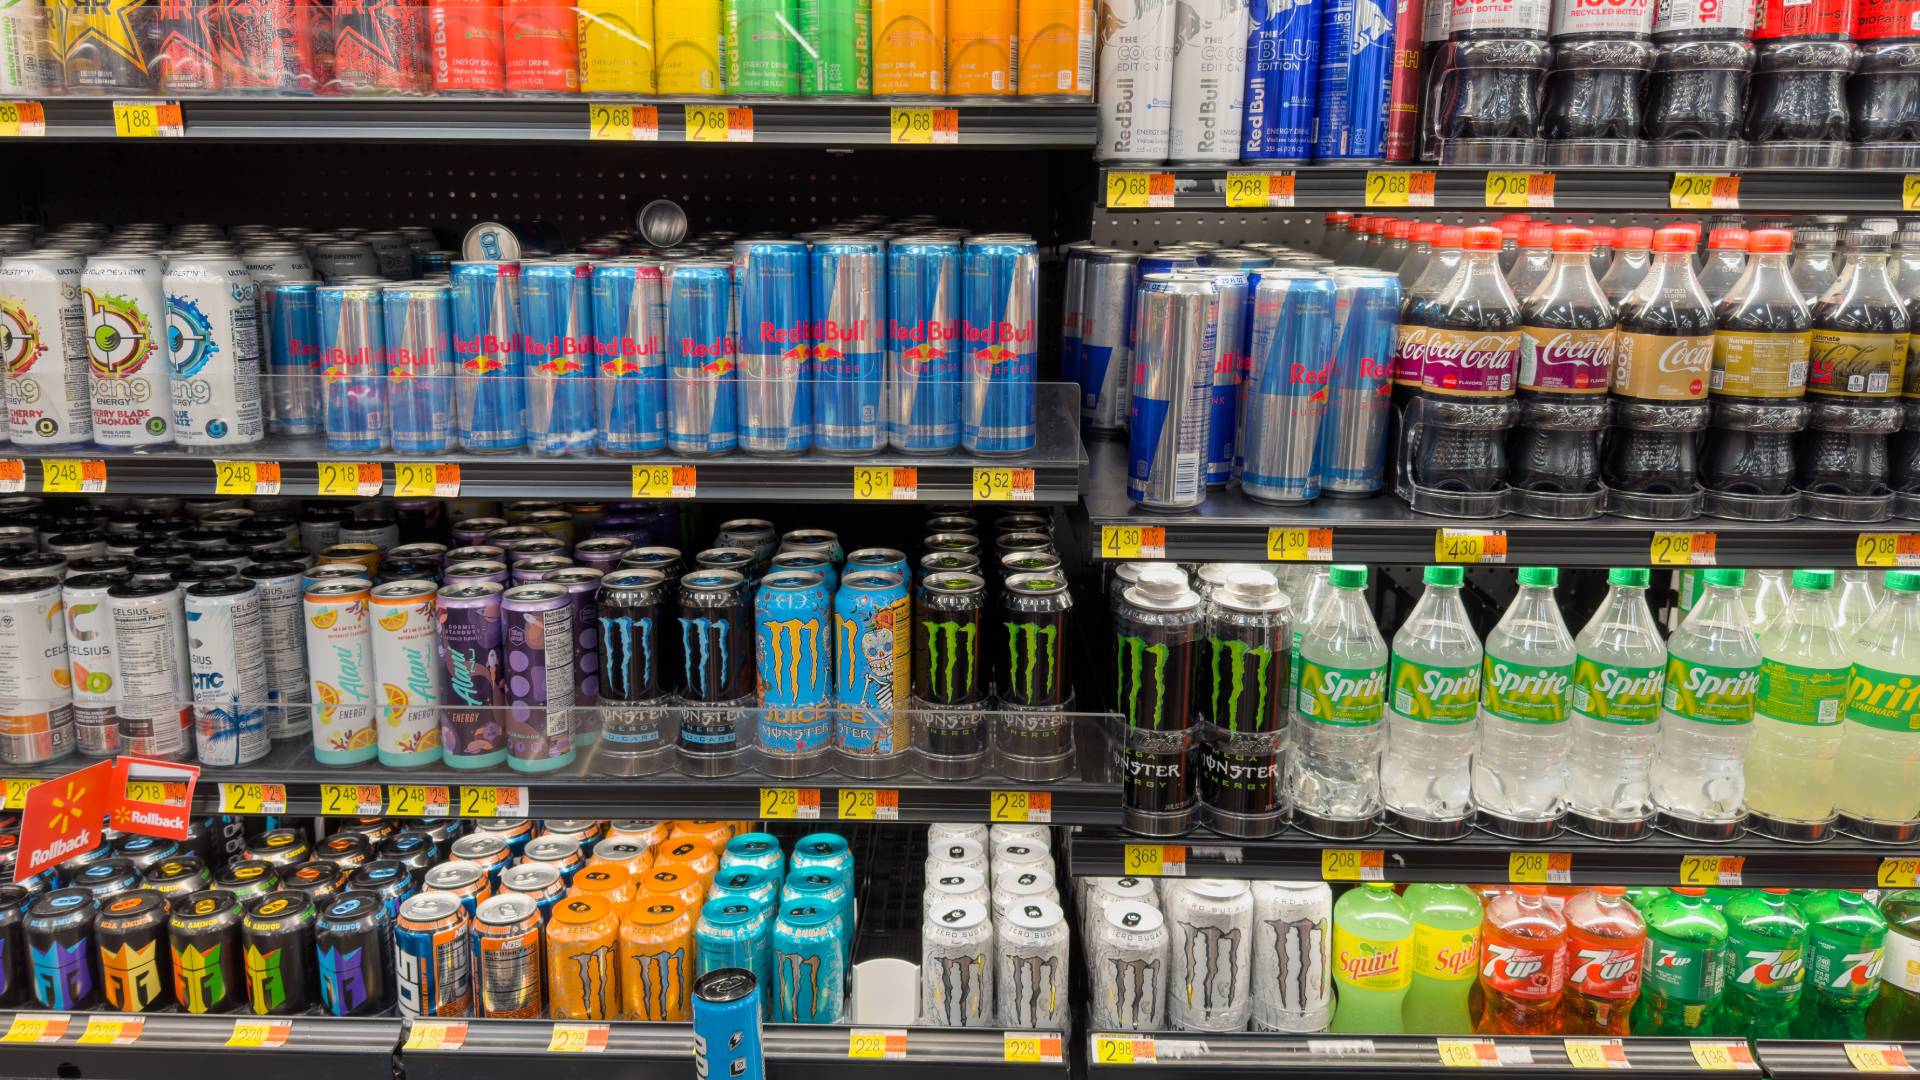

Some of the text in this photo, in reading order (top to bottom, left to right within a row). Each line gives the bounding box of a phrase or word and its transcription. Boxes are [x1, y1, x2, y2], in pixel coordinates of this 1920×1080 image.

[1118, 36, 1138, 44] THE
[1258, 39, 1321, 62] BLUE
[1117, 63, 1159, 72] EDITION
[1201, 63, 1240, 72] EDITION
[1257, 62, 1300, 71] EDITION
[1114, 79, 1134, 152] Red Bull
[1198, 79, 1218, 152] Red Bull
[1247, 78, 1265, 152] Red Bull
[761, 320, 801, 343] Red
[825, 320, 865, 342] Bull
[890, 320, 960, 341] Red Bull
[963, 320, 995, 343] Red
[999, 320, 1035, 343] Bull
[525, 336, 594, 355] Red Bull
[593, 336, 659, 356] Red Bull
[682, 337, 721, 357] Red
[1425, 333, 1516, 369] Coca-Cola
[400, 347, 436, 366] Bull
[1290, 363, 1328, 384] Red
[97, 398, 131, 406] ENERGY
[117, 409, 150, 418] BLADE
[113, 607, 149, 616] CELSIUS
[333, 645, 368, 702] Alani
[402, 646, 437, 703] Alani
[448, 646, 482, 706] Alani
[1490, 663, 1568, 695] Sprite
[338, 707, 367, 720] ENERGY
[408, 708, 434, 722] ENERGY
[452, 712, 480, 723] ENERGY
[764, 703, 828, 725] JUICE
[1852, 700, 1902, 718] LYMONADE
[130, 809, 184, 829] Rollback
[30, 829, 90, 869] Rollback
[253, 922, 281, 931] AMINOS
[330, 922, 361, 932] AMINOS
[935, 925, 987, 938] ZERO SUGAR
[1009, 927, 1062, 939] ZERO SUGAR
[1112, 931, 1163, 941] ZERO SUGAR
[1338, 945, 1400, 979] Squirt
